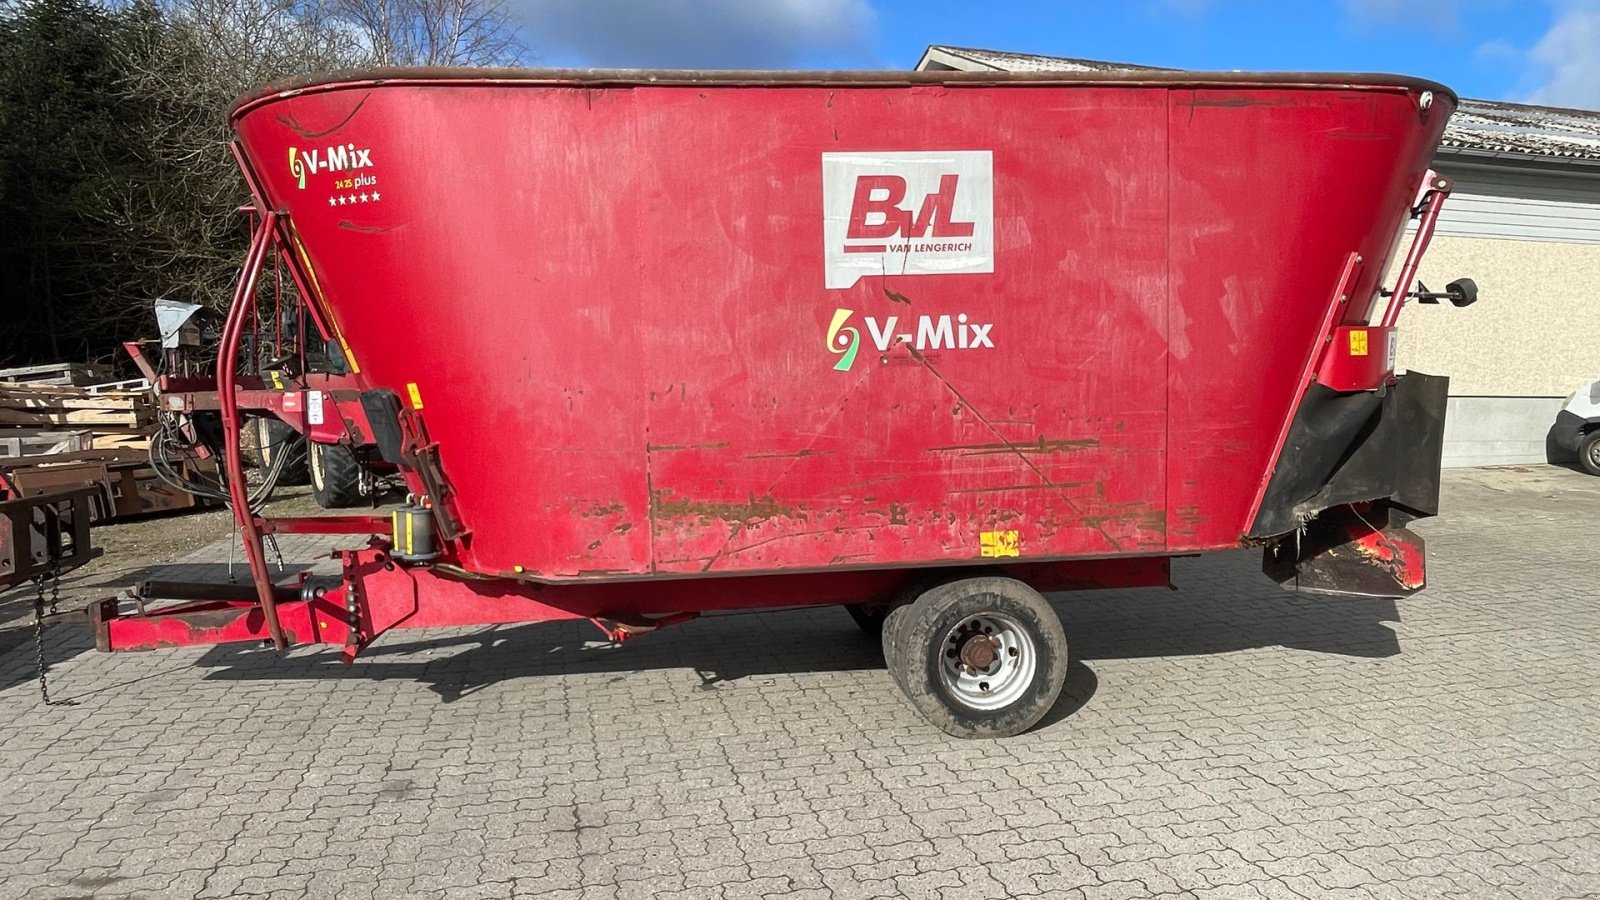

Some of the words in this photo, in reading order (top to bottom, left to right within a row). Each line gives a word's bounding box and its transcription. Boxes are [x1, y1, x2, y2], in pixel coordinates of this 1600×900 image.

[301, 143, 374, 174] V-Mix
[354, 173, 377, 190] plus
[889, 244, 912, 253] VAN
[914, 243, 972, 253] LENGERICH
[864, 313, 995, 351] V-Mix
